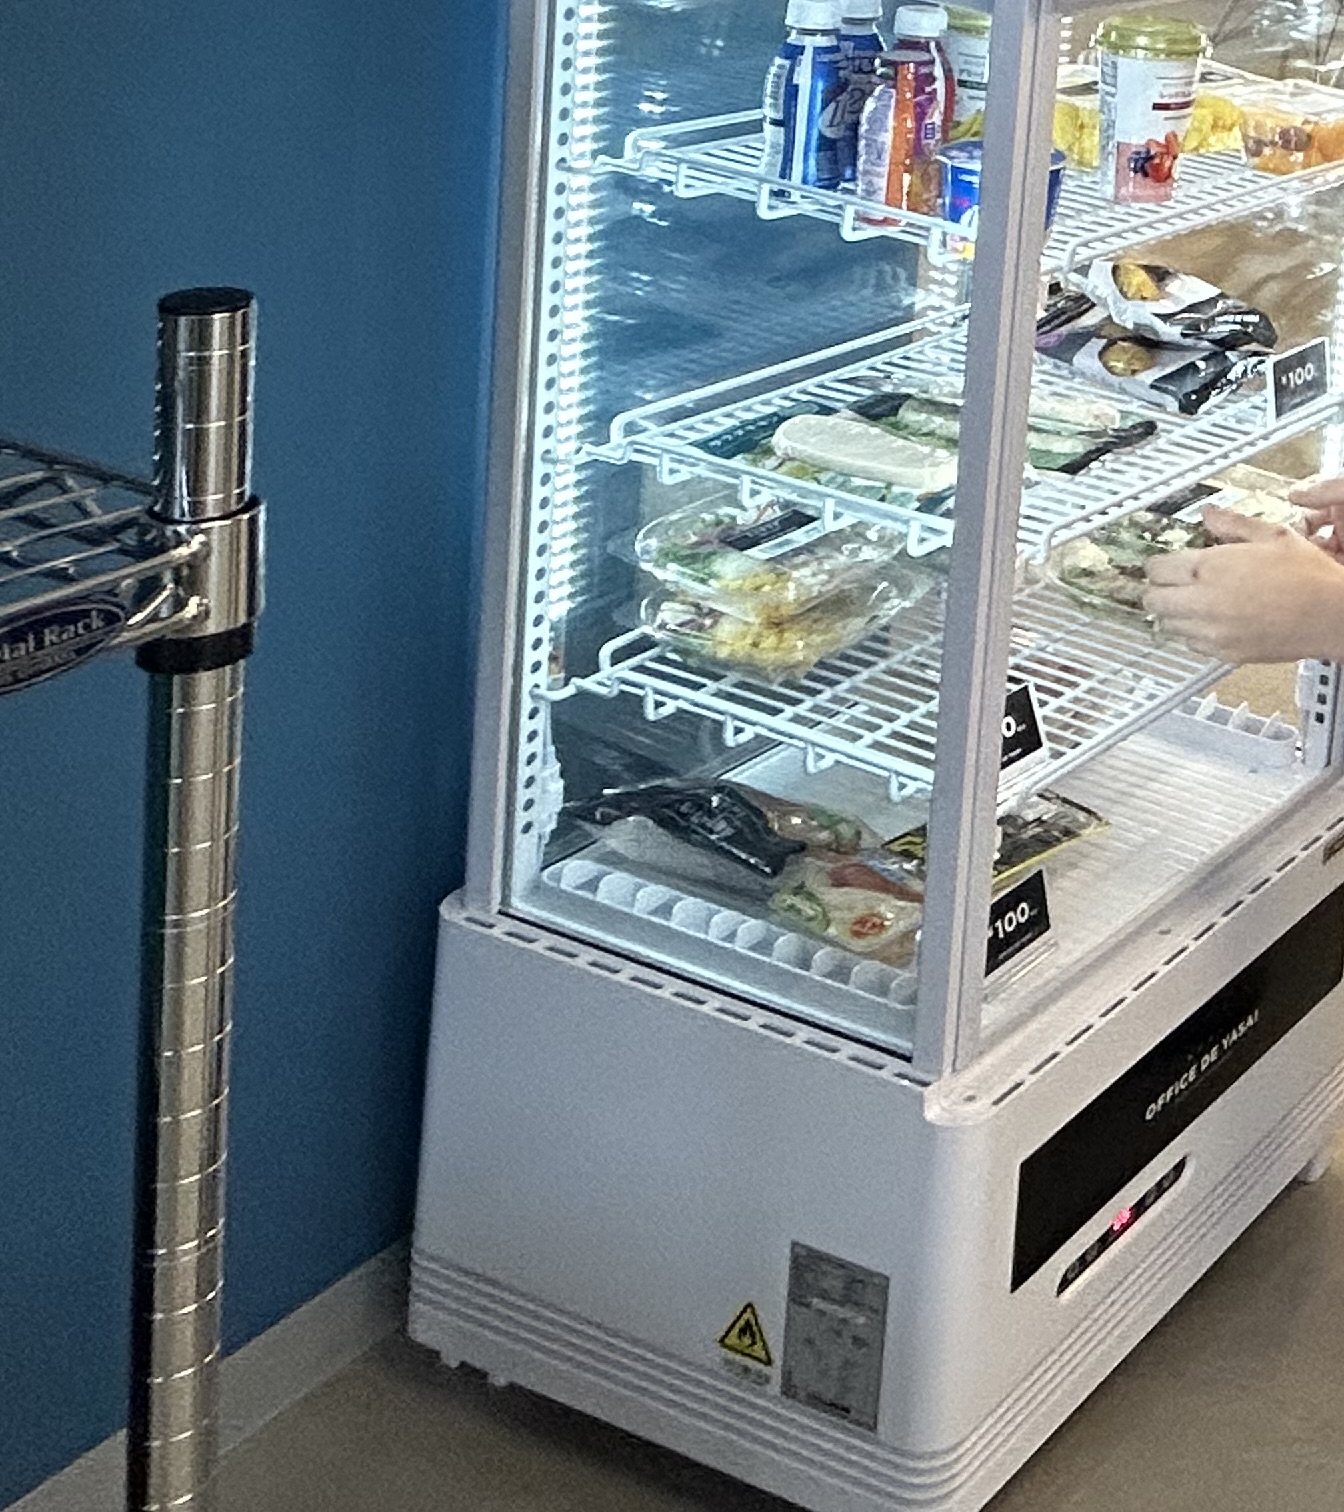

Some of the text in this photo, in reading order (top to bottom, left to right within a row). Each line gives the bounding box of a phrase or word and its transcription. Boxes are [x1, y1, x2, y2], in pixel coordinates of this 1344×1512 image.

[44, 609, 105, 648] Rack
[1144, 1008, 1260, 1121] OFFICE DE YASAI
